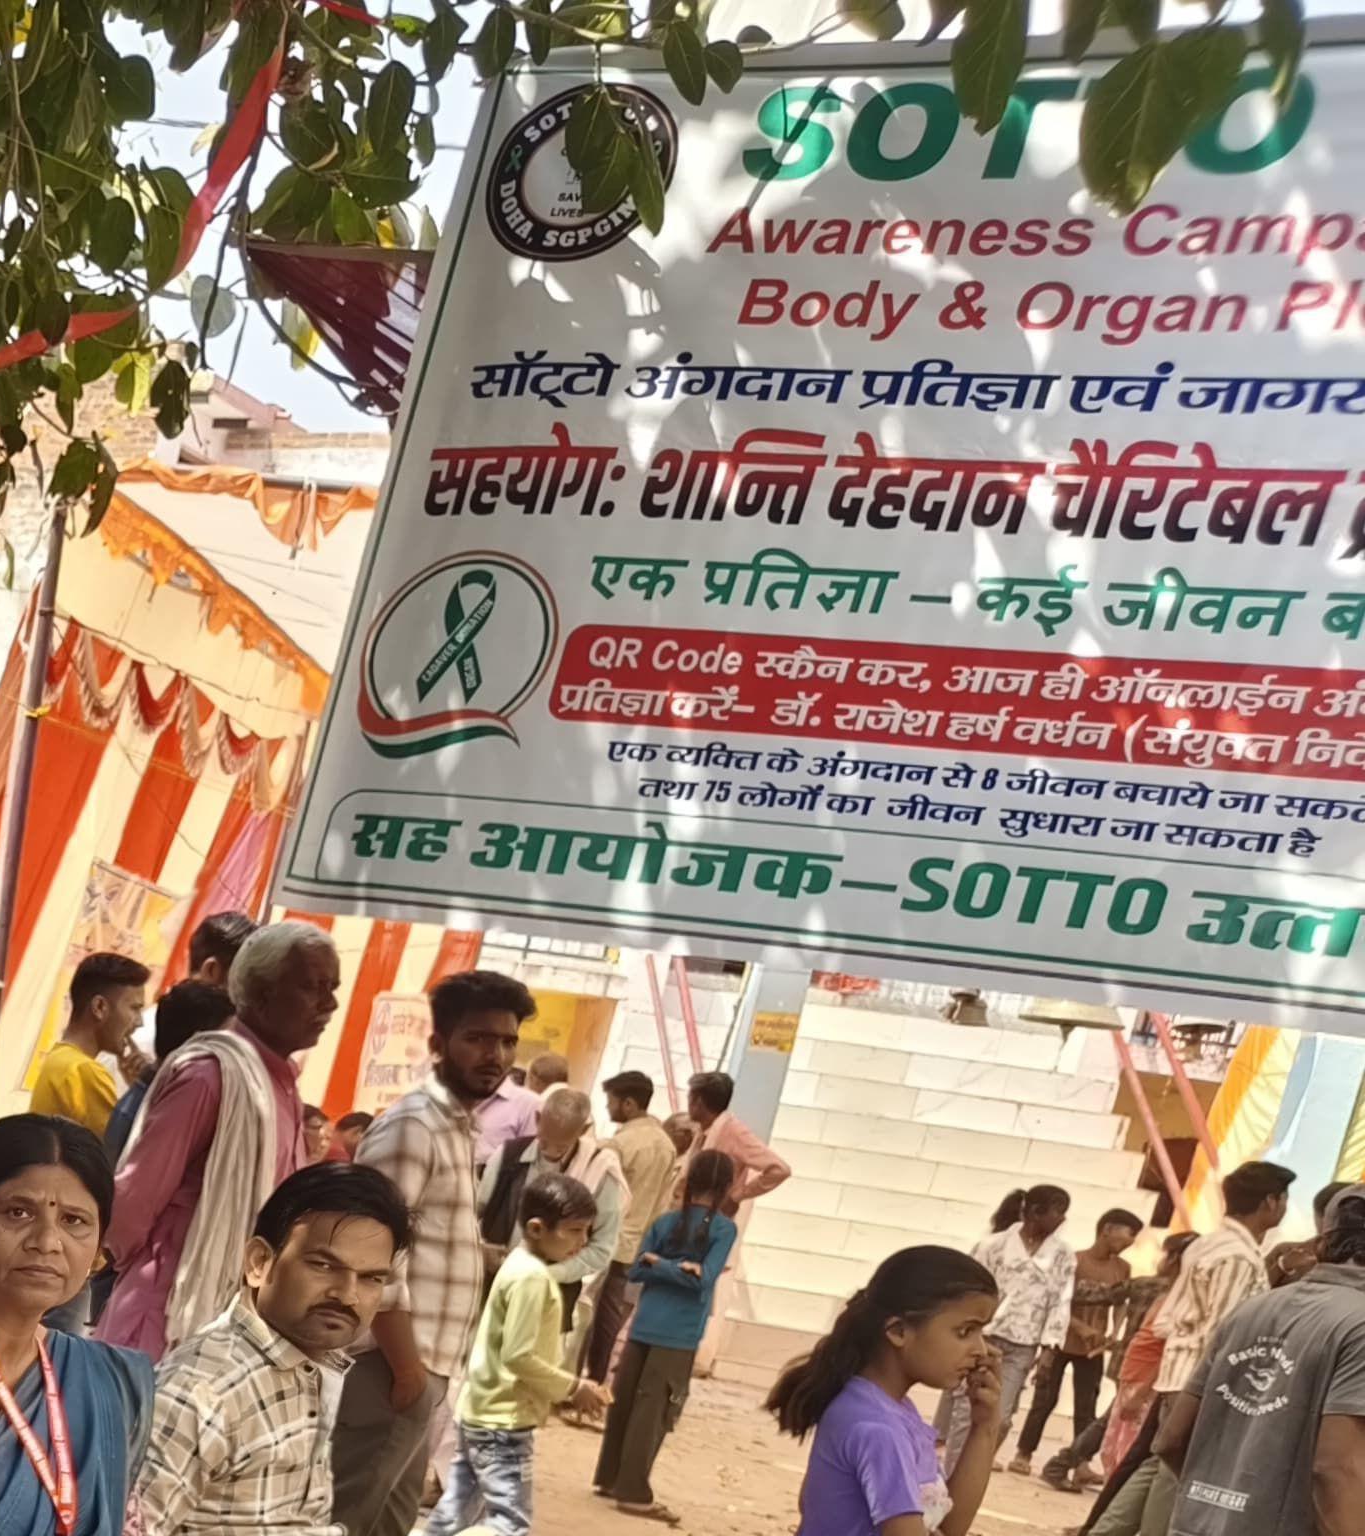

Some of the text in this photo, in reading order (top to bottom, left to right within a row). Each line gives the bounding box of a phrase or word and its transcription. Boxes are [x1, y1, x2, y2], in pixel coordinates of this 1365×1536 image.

[742, 68, 1315, 181] SOTO
[500, 180, 637, 247] DOHA, SGPGIM
[558, 191, 583, 202] SAV
[707, 207, 1095, 257] Awareness
[737, 278, 1365, 346] Body & Organ Pl
[624, 351, 852, 403] अंगदान
[859, 358, 1061, 414] प्रतिज्ञा
[1069, 361, 1174, 414] एवं
[424, 421, 626, 518] सहयोग:
[639, 428, 828, 526] शान्ति
[827, 431, 1052, 535] देहदान
[1050, 438, 1348, 548] चैरिटेबल
[591, 555, 689, 601] एक
[702, 547, 899, 614] प्रतिज्ञा
[976, 563, 1088, 638] कई
[1103, 566, 1306, 637] जीवन
[588, 635, 642, 673] QR
[651, 639, 743, 676] Code
[754, 645, 853, 685] स्कैन
[856, 658, 932, 694] कर,
[943, 663, 1039, 698] आज
[1040, 662, 1088, 700] ही
[1091, 667, 1310, 717] ऑनलाईन
[557, 677, 670, 718] प्रतिज्ञा
[770, 690, 821, 727] डॉ.
[833, 698, 943, 738] राजेश
[944, 706, 1012, 743] हर्ष
[1012, 710, 1117, 750] वर्धन
[607, 740, 662, 763] एक
[665, 741, 762, 772] व्यक्ति
[766, 747, 803, 774] के
[807, 751, 937, 786] अंगदान
[941, 762, 977, 790] से
[980, 767, 1000, 792] 8
[1005, 767, 1109, 801] जीवन
[1113, 781, 1214, 810] बचाये
[1217, 790, 1270, 815] जा
[349, 813, 464, 863] सह
[637, 776, 1322, 858] तथा 75 लोगों का जीवन सुधारा जा सकता है
